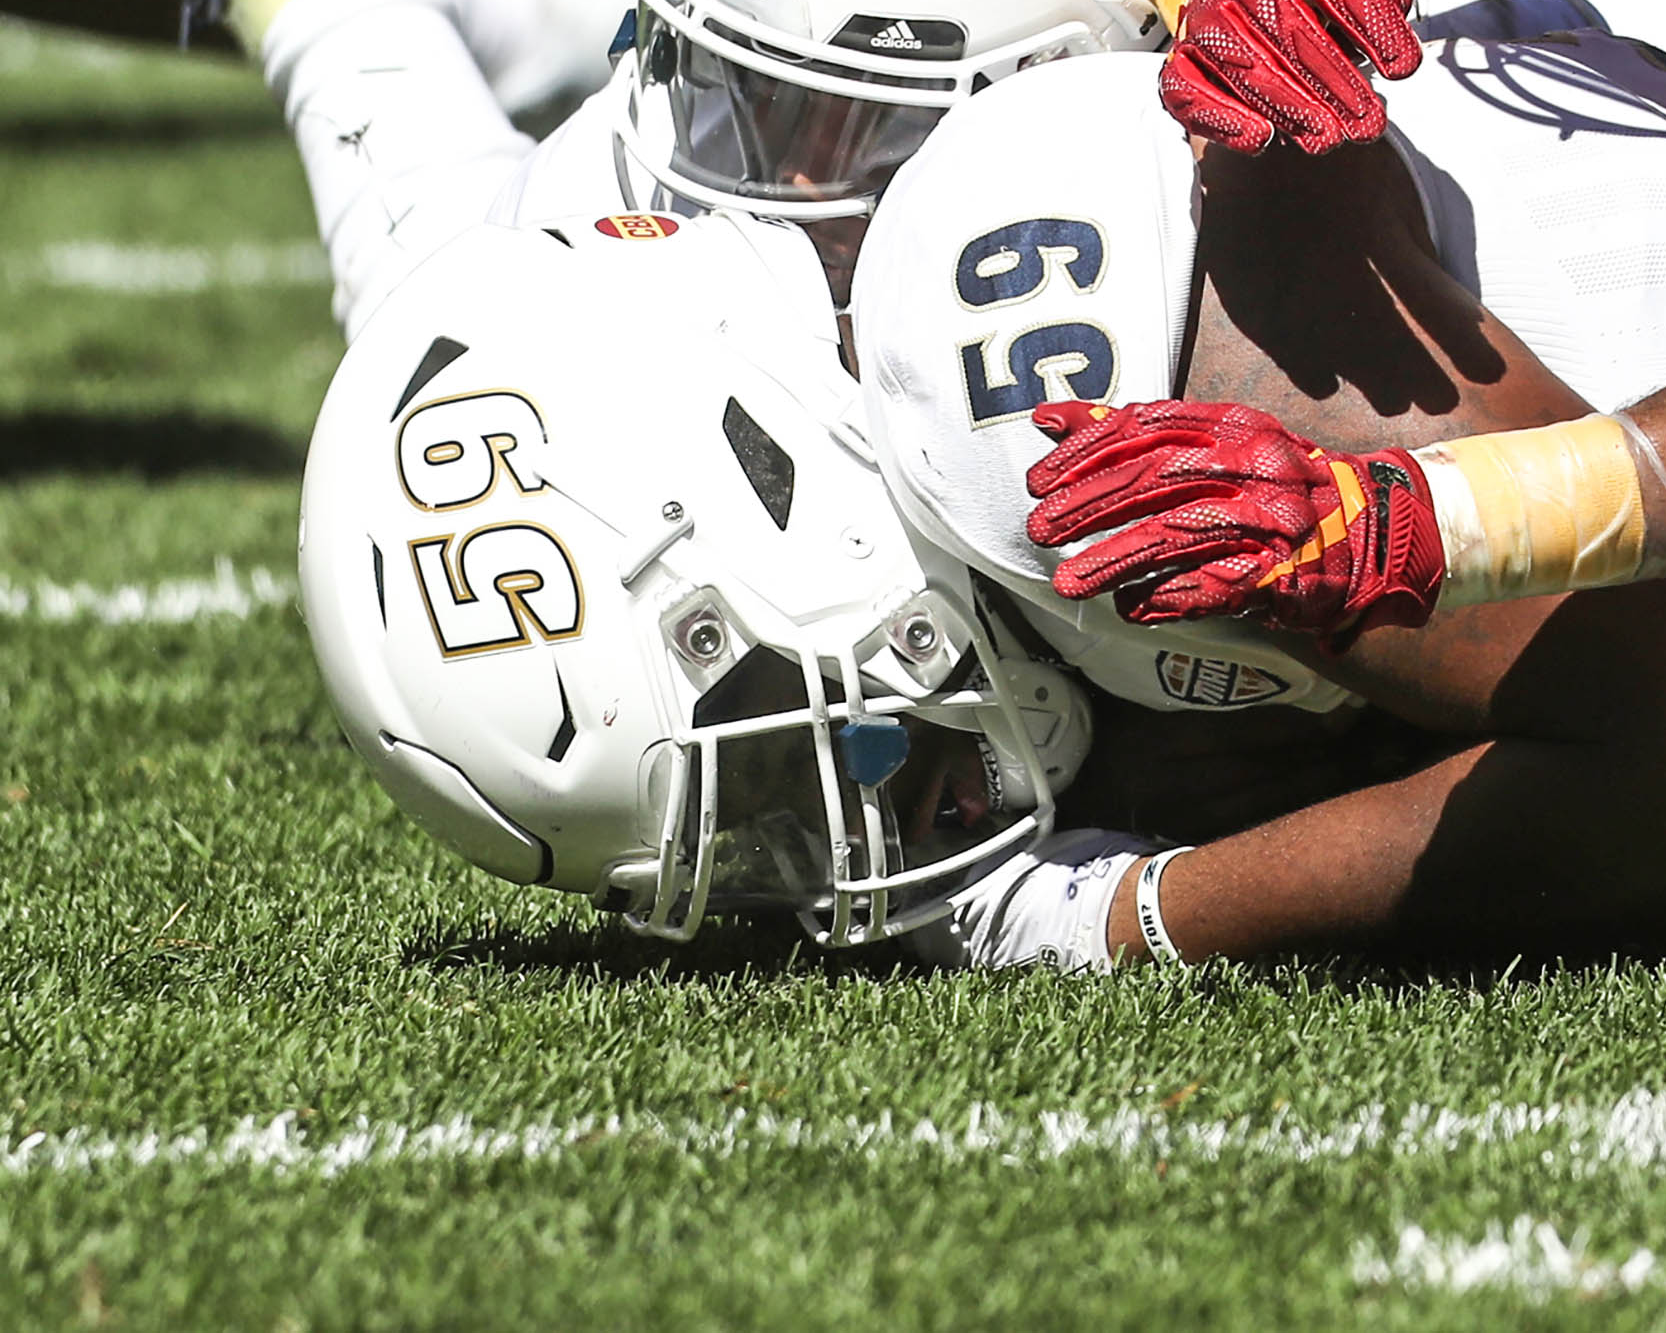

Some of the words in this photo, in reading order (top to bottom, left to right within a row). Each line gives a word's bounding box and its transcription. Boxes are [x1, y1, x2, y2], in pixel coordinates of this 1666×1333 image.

[870, 37, 923, 50] adidas
[953, 213, 1119, 431] 59
[397, 388, 585, 662] 59
[1141, 904, 1162, 947] FOR?
